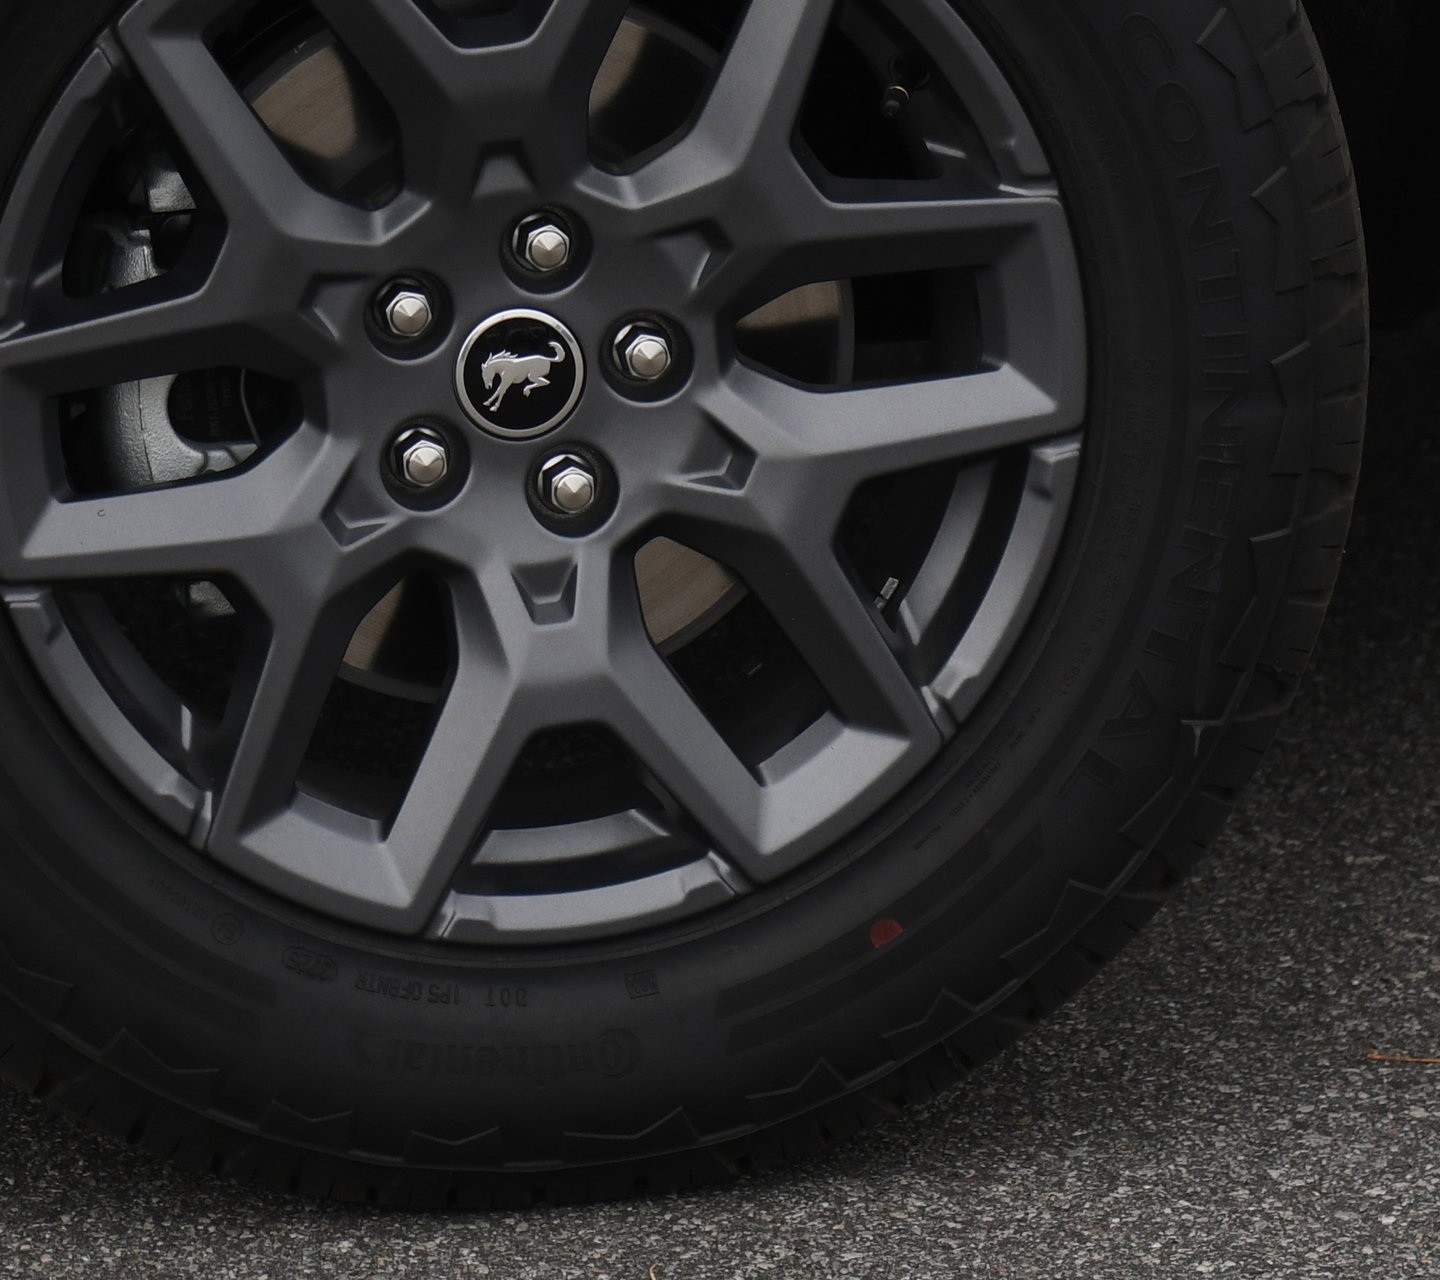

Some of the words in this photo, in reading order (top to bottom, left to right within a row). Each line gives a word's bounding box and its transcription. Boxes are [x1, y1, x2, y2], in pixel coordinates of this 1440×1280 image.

[1053, 5, 1249, 822] CONTINENTAL
[485, 985, 527, 1009] DOT
[381, 1024, 645, 1087] Continental
